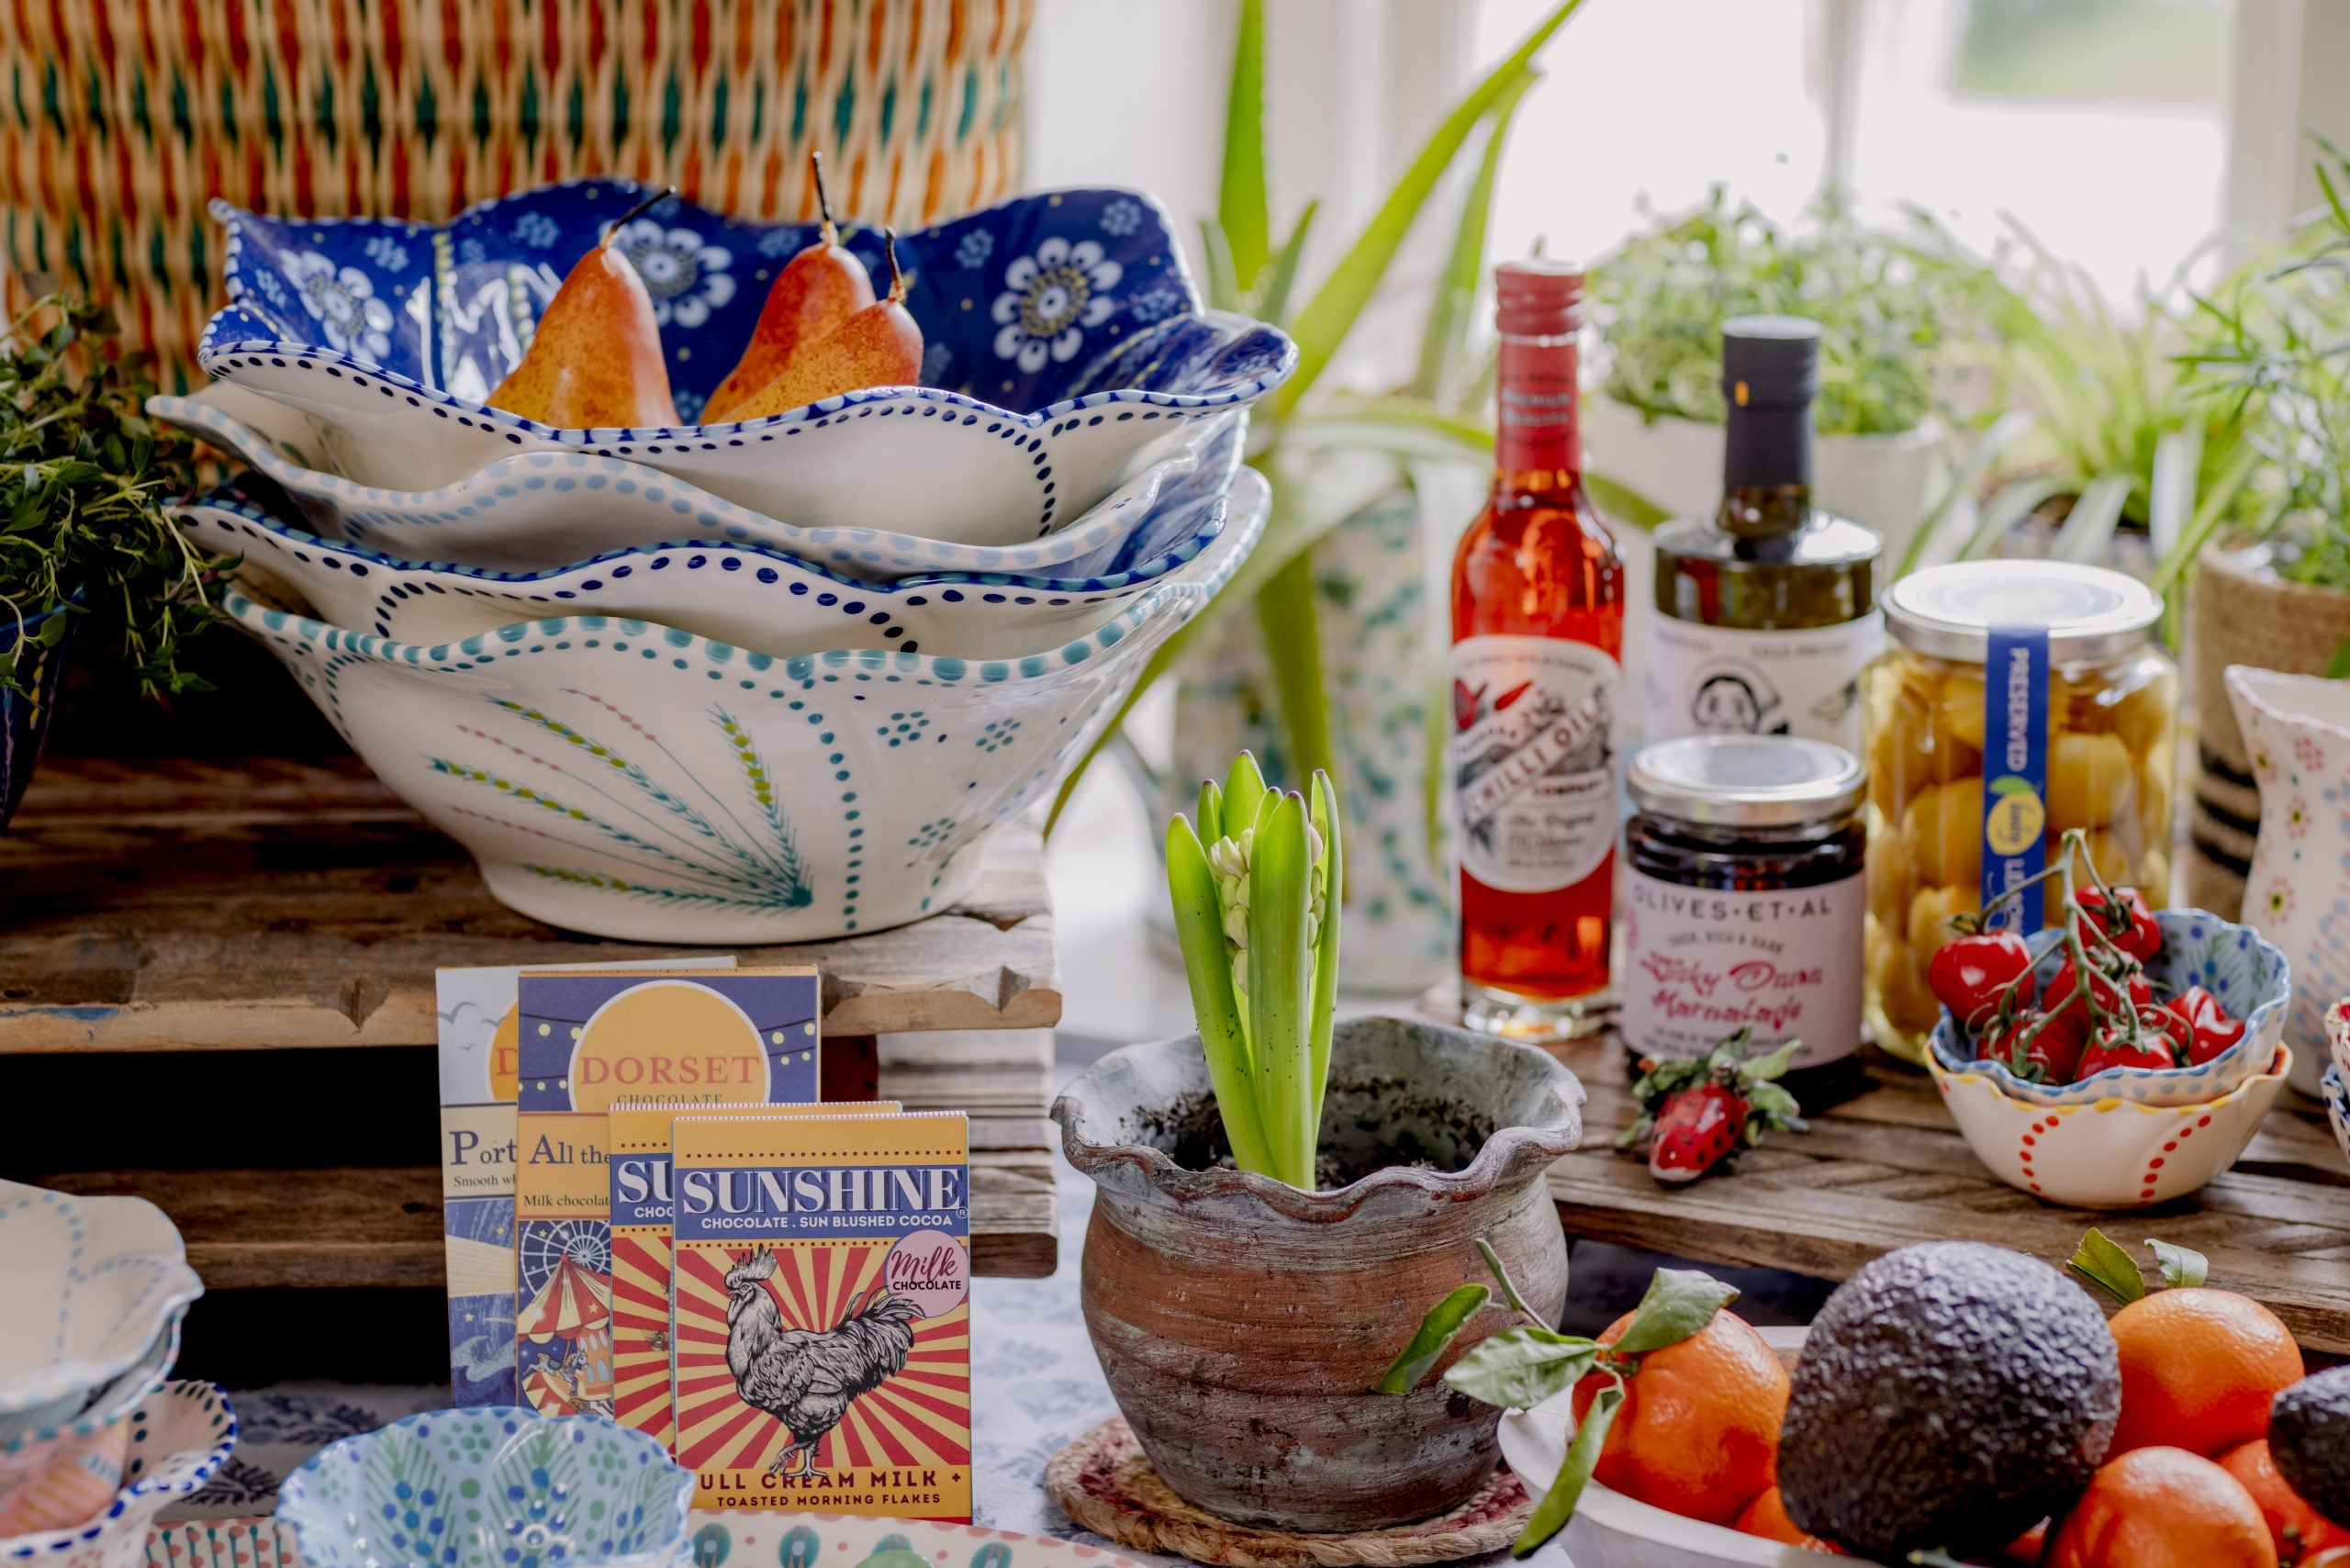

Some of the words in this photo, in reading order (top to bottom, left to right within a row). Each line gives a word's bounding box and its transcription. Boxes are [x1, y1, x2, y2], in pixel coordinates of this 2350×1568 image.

[2006, 646, 2031, 772] PRESERVED
[580, 1055, 760, 1085] DORSET
[616, 1093, 723, 1104] CHOCOLATE
[528, 1133, 575, 1165] All
[453, 1174, 499, 1188] Smooth
[523, 1194, 554, 1206] Milk
[556, 1193, 611, 1207] chocolat
[683, 1168, 961, 1215] SUNSHINE
[700, 1215, 789, 1230] CHOCOLATE
[800, 1215, 829, 1228] SUN
[833, 1215, 896, 1227] BLUSHED
[899, 1215, 954, 1226] COCOA
[890, 1245, 958, 1282] Milk
[892, 1280, 962, 1291] CHOCOLATE
[699, 1473, 746, 1490] ULL
[761, 1472, 855, 1490] CREAM
[870, 1470, 937, 1488] MILK
[717, 1495, 789, 1507] TOASTED
[797, 1494, 875, 1506] MORNING
[882, 1493, 941, 1505] FLAKES
